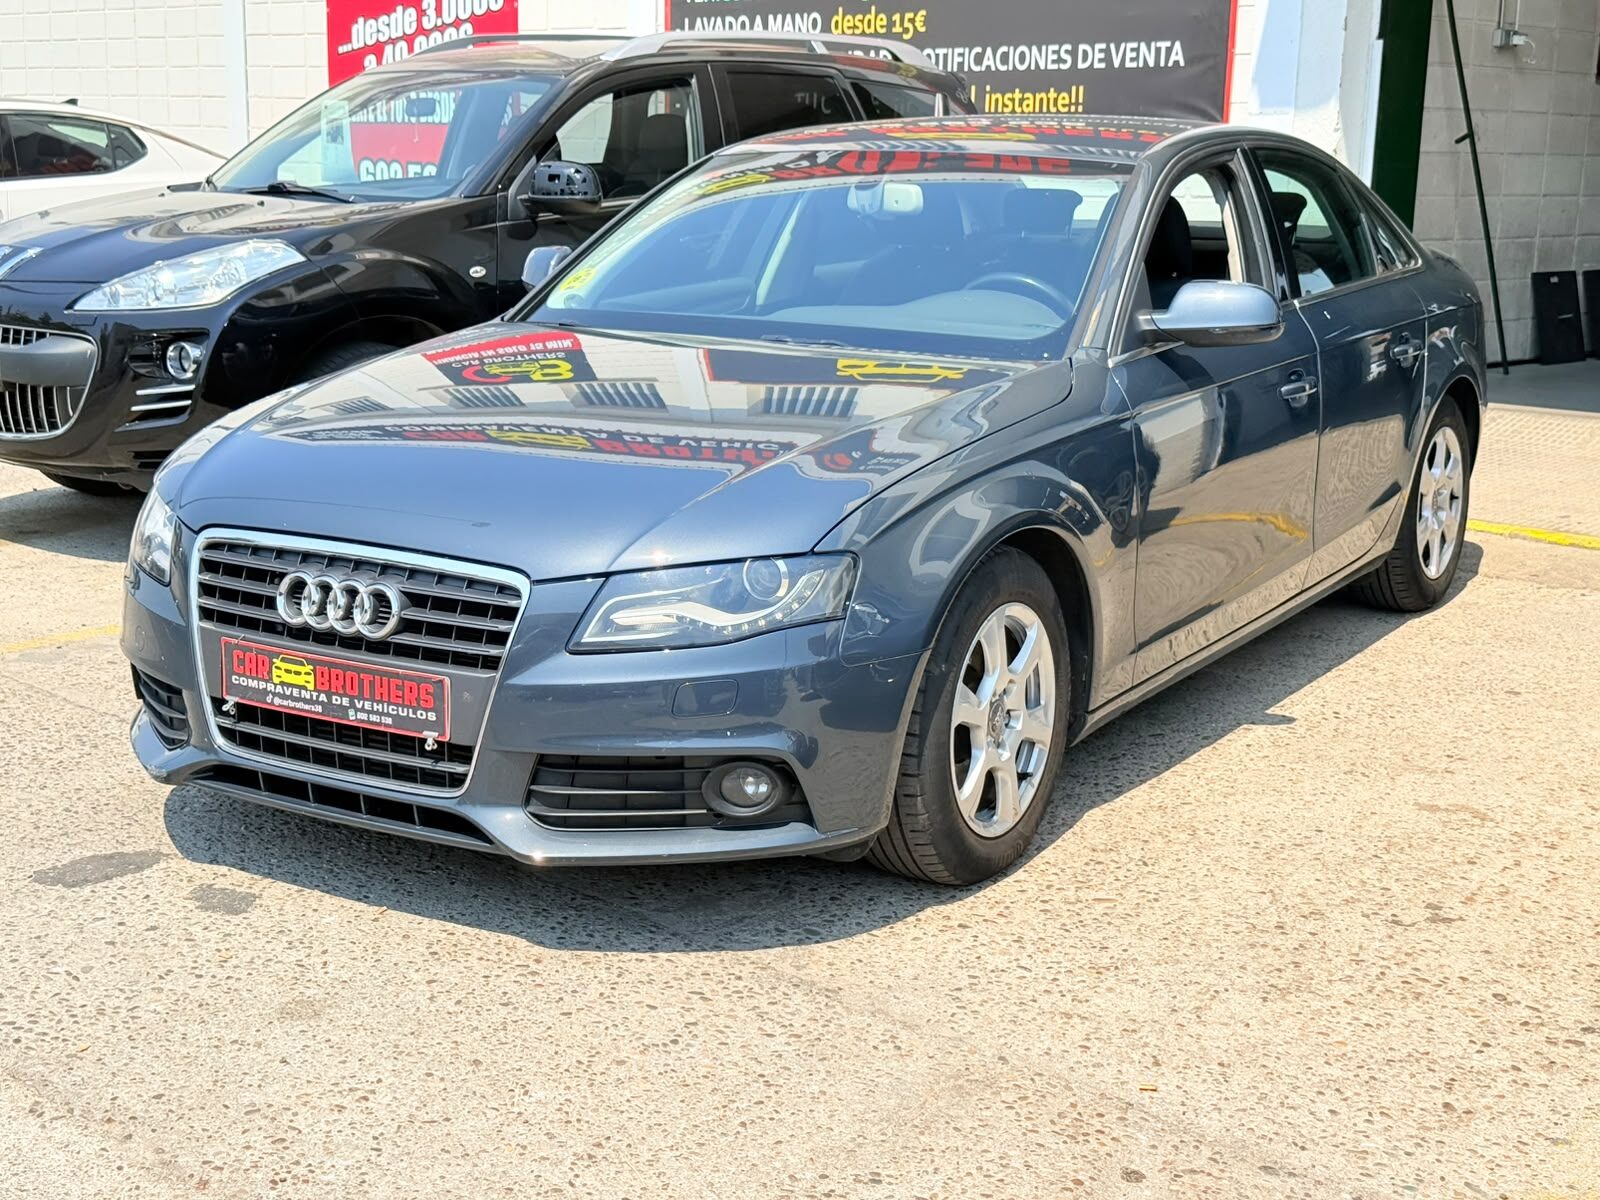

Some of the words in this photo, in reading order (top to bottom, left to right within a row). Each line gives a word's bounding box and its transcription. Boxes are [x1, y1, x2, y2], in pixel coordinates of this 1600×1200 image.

[767, 12, 822, 34] MANO
[830, 6, 887, 35] desde
[891, 9, 927, 40] 15€
[1077, 43, 1107, 69] DE
[1109, 40, 1185, 68] VENTA
[984, 85, 1085, 114] instante!!
[231, 649, 270, 680] CAR
[315, 665, 435, 710] BROTHERS
[231, 674, 328, 704] COMPRAVENTA
[332, 694, 350, 707] DE
[354, 698, 437, 722] VEHÍCULOS
[273, 696, 323, 714] @carbrothers38
